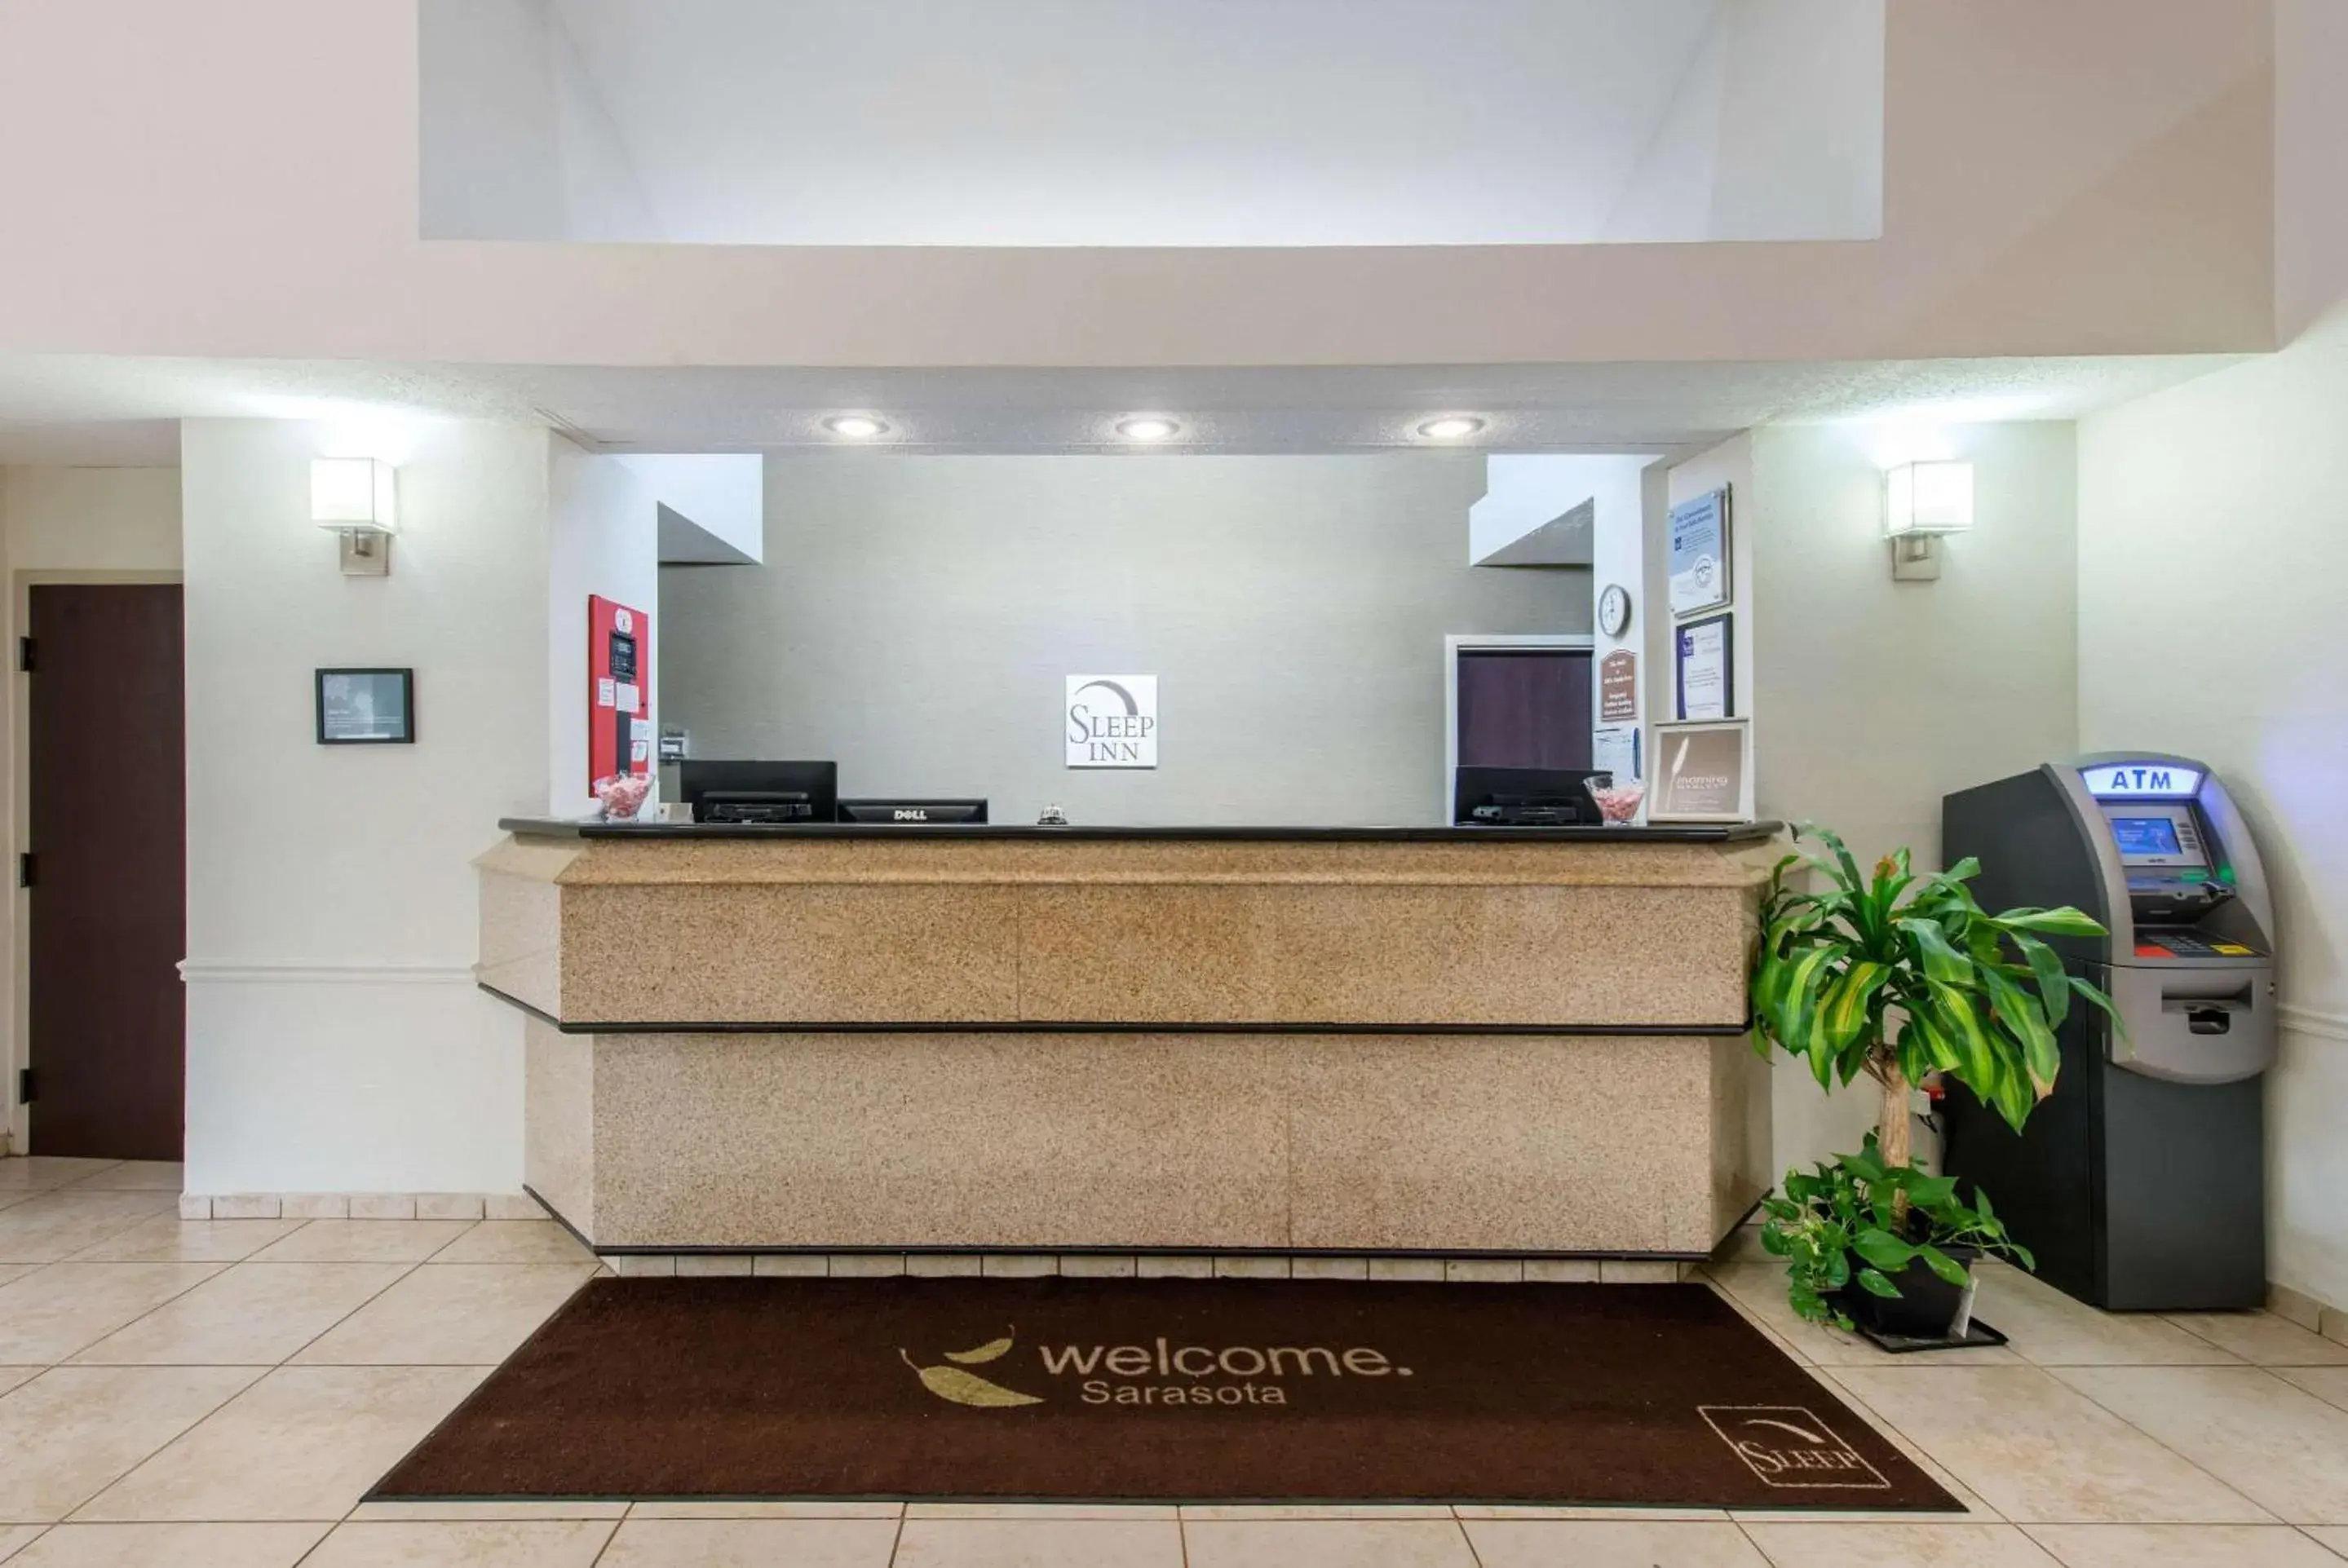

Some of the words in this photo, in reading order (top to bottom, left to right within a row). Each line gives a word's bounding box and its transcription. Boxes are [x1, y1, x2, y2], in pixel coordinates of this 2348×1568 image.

[1070, 704, 1154, 744] SLEEP
[1090, 742, 1140, 762] INN
[2111, 769, 2171, 789] ATM
[893, 810, 927, 820] DELL
[1040, 1337, 1413, 1376] welcome.
[1081, 1380, 1287, 1405] Sarasota
